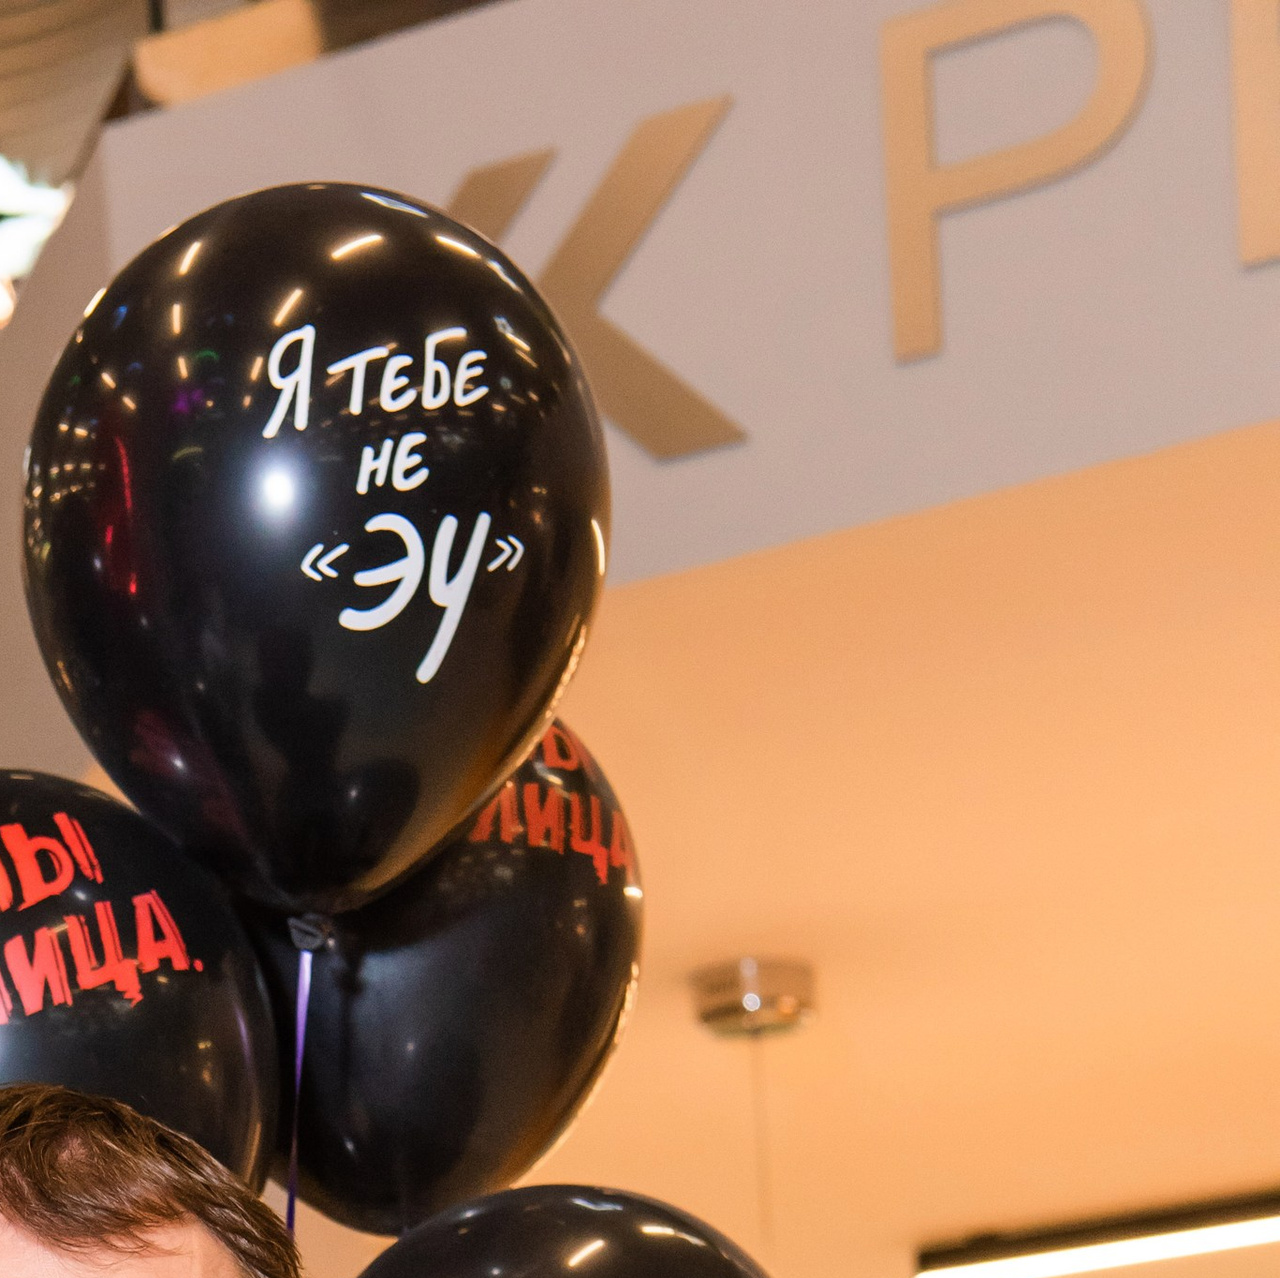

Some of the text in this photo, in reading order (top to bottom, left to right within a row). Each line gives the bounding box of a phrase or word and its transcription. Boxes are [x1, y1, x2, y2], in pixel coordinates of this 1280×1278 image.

[262, 324, 488, 439] Я ТЕБЕ
[355, 431, 430, 495] НЕ
